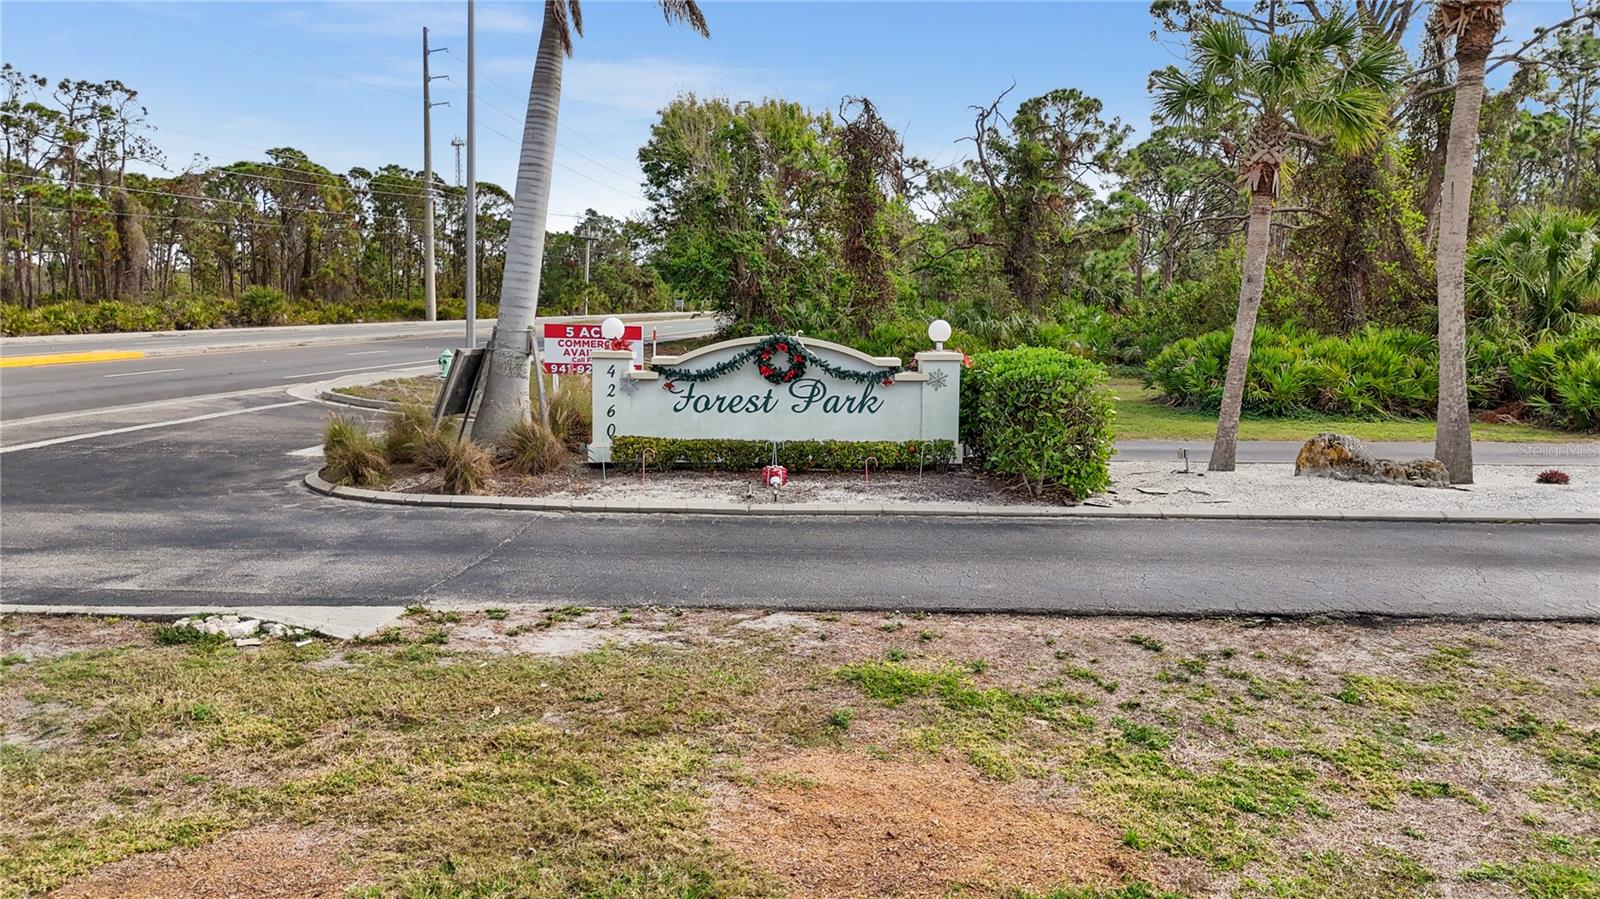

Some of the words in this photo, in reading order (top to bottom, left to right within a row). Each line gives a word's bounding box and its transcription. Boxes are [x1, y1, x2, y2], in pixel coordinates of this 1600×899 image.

[566, 327, 574, 337] 5
[579, 327, 601, 338] AC
[558, 340, 610, 349] COMMERC
[551, 364, 592, 374] 941-92
[669, 378, 779, 413] Forest
[788, 378, 884, 414] Park
[607, 364, 616, 440] 4260
